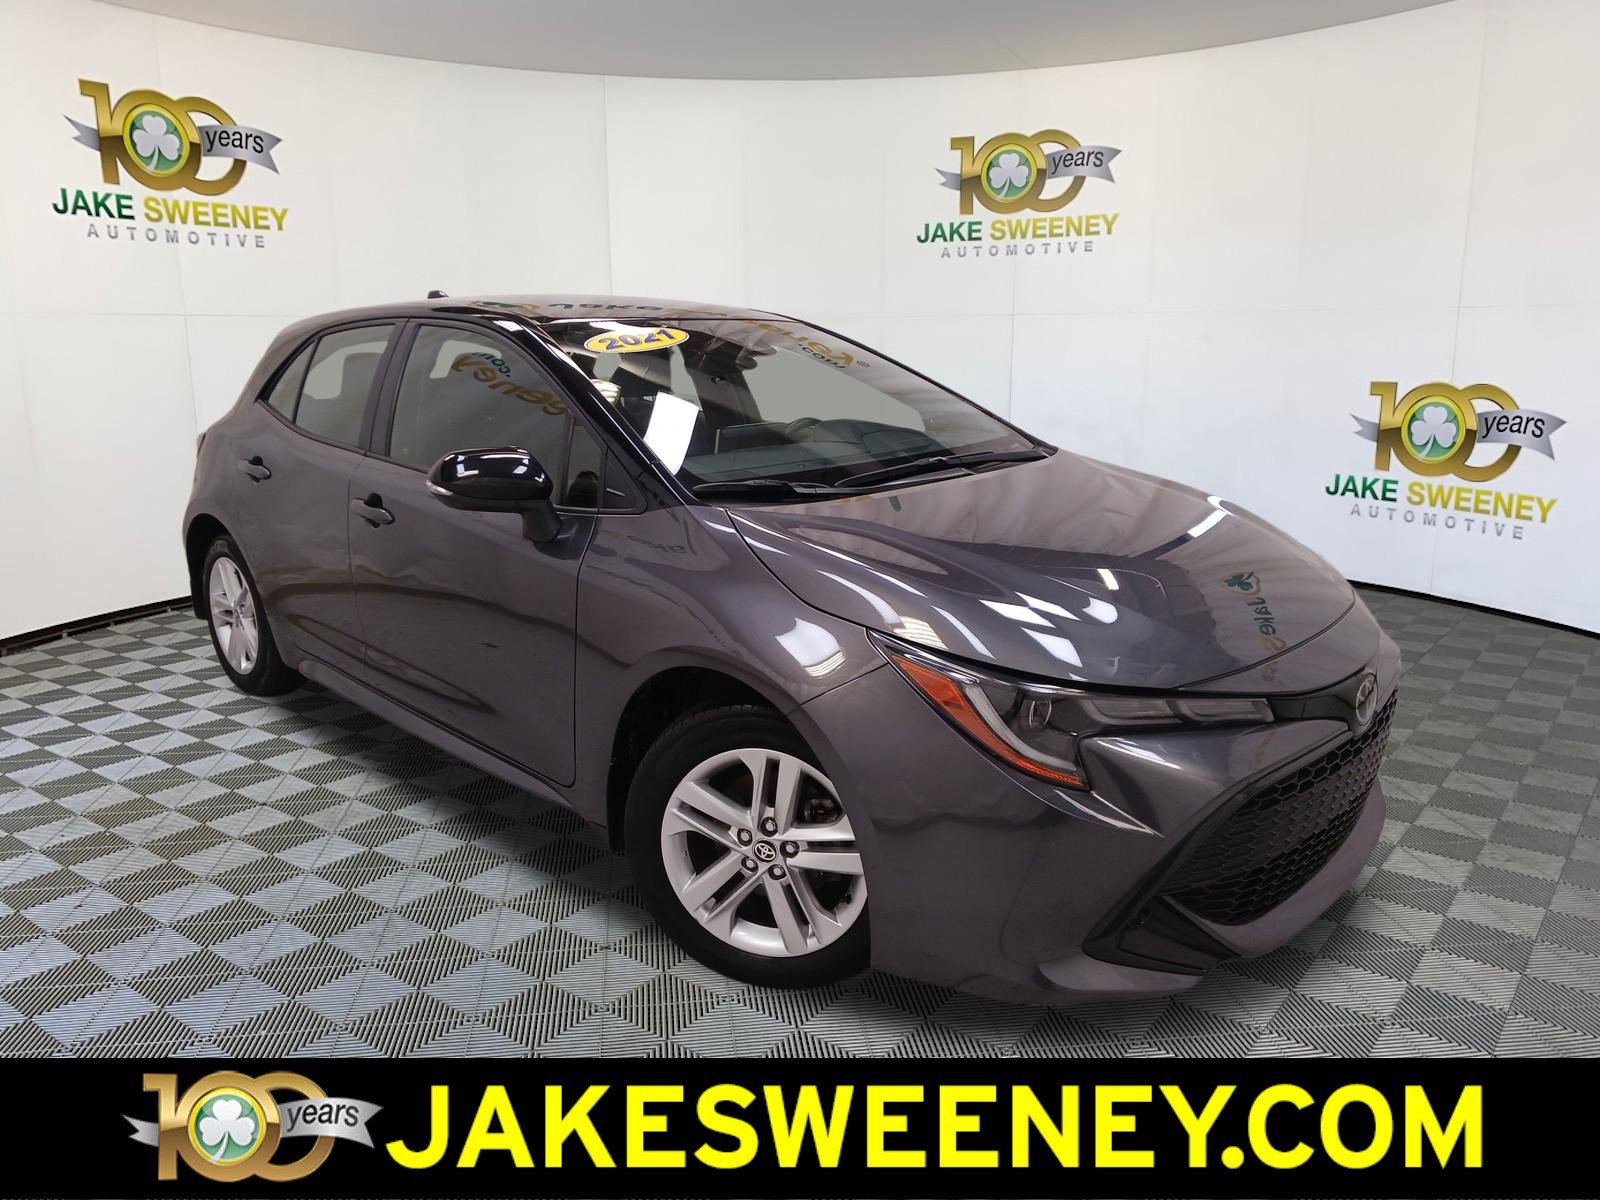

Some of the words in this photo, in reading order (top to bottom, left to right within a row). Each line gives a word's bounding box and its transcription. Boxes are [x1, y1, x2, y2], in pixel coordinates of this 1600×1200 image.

[78, 79, 247, 196] 100
[205, 129, 264, 154] years
[950, 129, 1087, 214] 100
[1051, 150, 1104, 174] years
[52, 188, 136, 220] JAKE
[143, 196, 288, 231] SWEENEY
[916, 220, 983, 244] JAKE
[990, 213, 1120, 241] SWEENEY
[87, 223, 265, 248] AUTOMOTIVE
[941, 240, 1093, 259] AUTOMOTIVE
[598, 329, 677, 350] 2021
[1369, 381, 1523, 482] 100
[1482, 414, 1545, 439] years
[1325, 474, 1400, 502] JAKE
[1406, 480, 1558, 524] SWEENEY
[1350, 503, 1524, 540] AUTOMOTIVE
